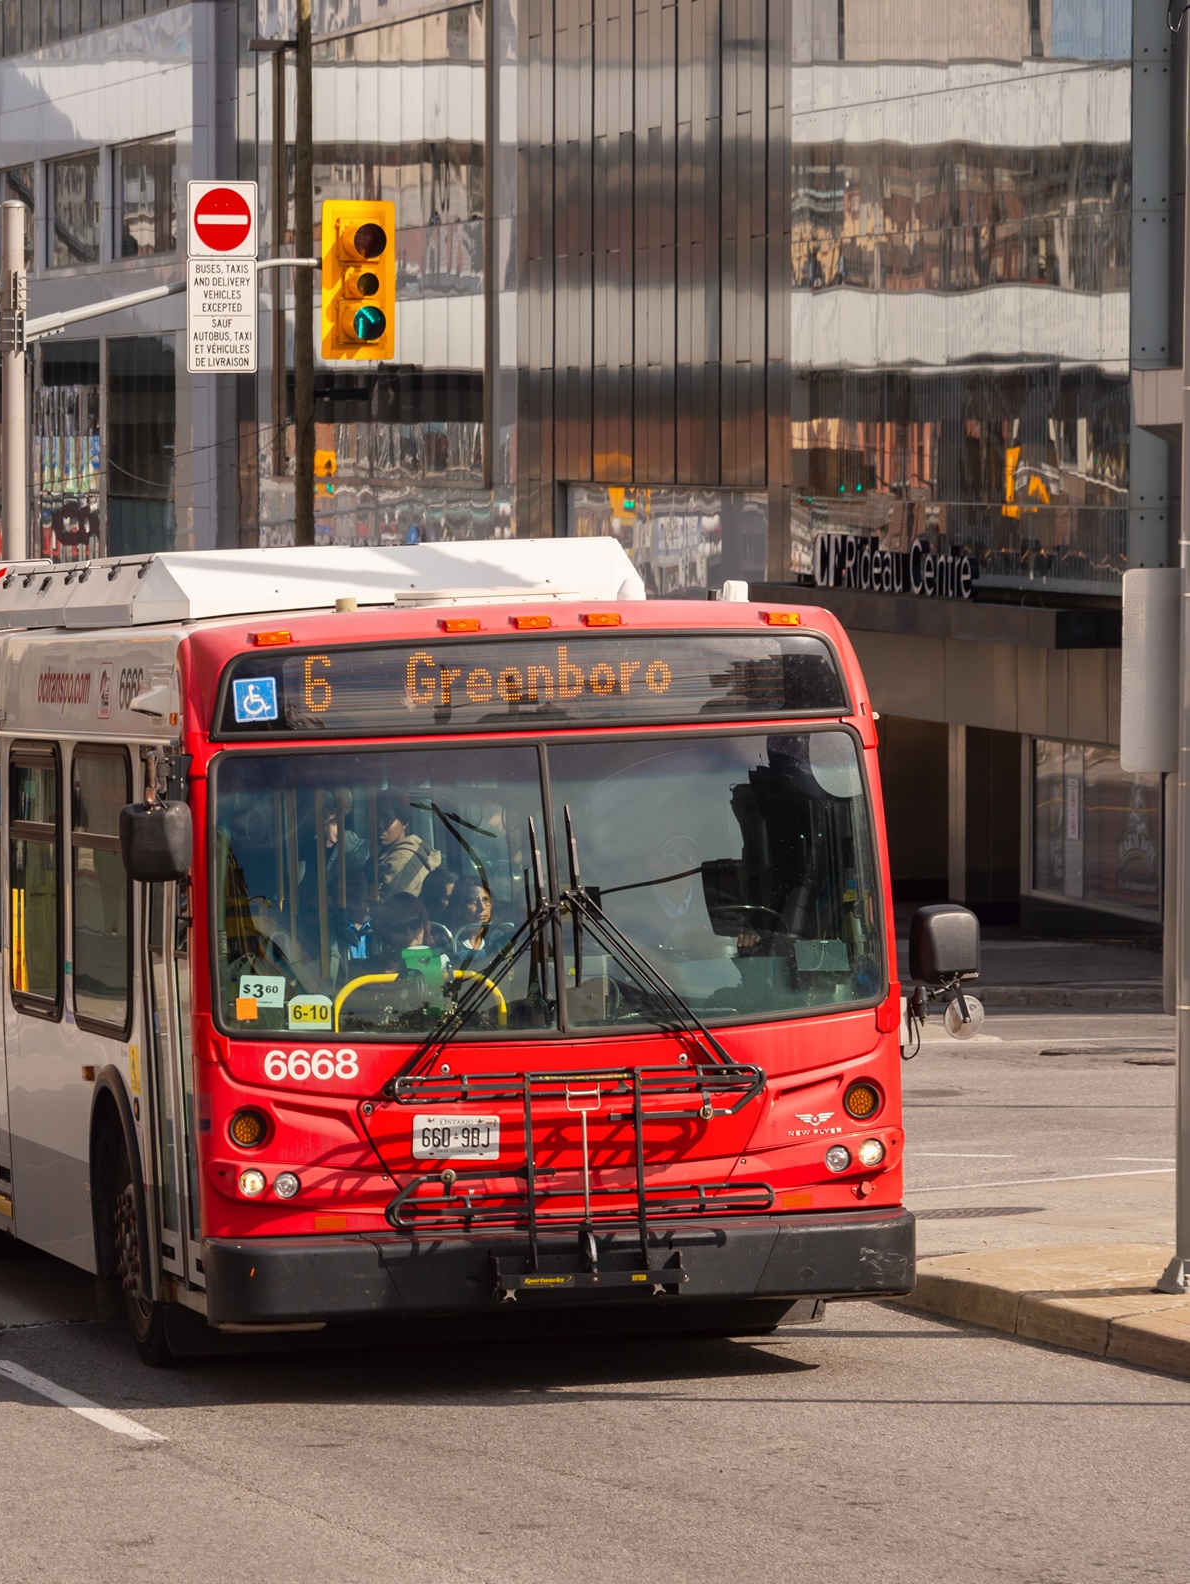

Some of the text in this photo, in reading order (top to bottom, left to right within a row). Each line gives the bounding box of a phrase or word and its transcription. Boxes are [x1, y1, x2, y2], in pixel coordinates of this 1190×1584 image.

[195, 264, 249, 275] BUSES, TAXIS
[193, 277, 251, 287] AND DELIVERY
[203, 290, 242, 300] VEHICLES
[202, 303, 243, 313] EXCEPTED
[211, 319, 233, 329] SAUF
[193, 332, 252, 342] AUTOBUS, TAXI
[194, 343, 250, 354] ET VÉHICULES
[195, 357, 250, 367] DE LIVRAISON
[813, 533, 973, 599] CF Rideau Centre
[304, 646, 672, 712] 6 Greenboro
[37, 665, 91, 715] octranspo.com
[293, 1005, 329, 1020] 6-10
[264, 1048, 360, 1081] 6668
[813, 1127, 843, 1135] FLYER
[524, 1276, 565, 1286] Sportworks
